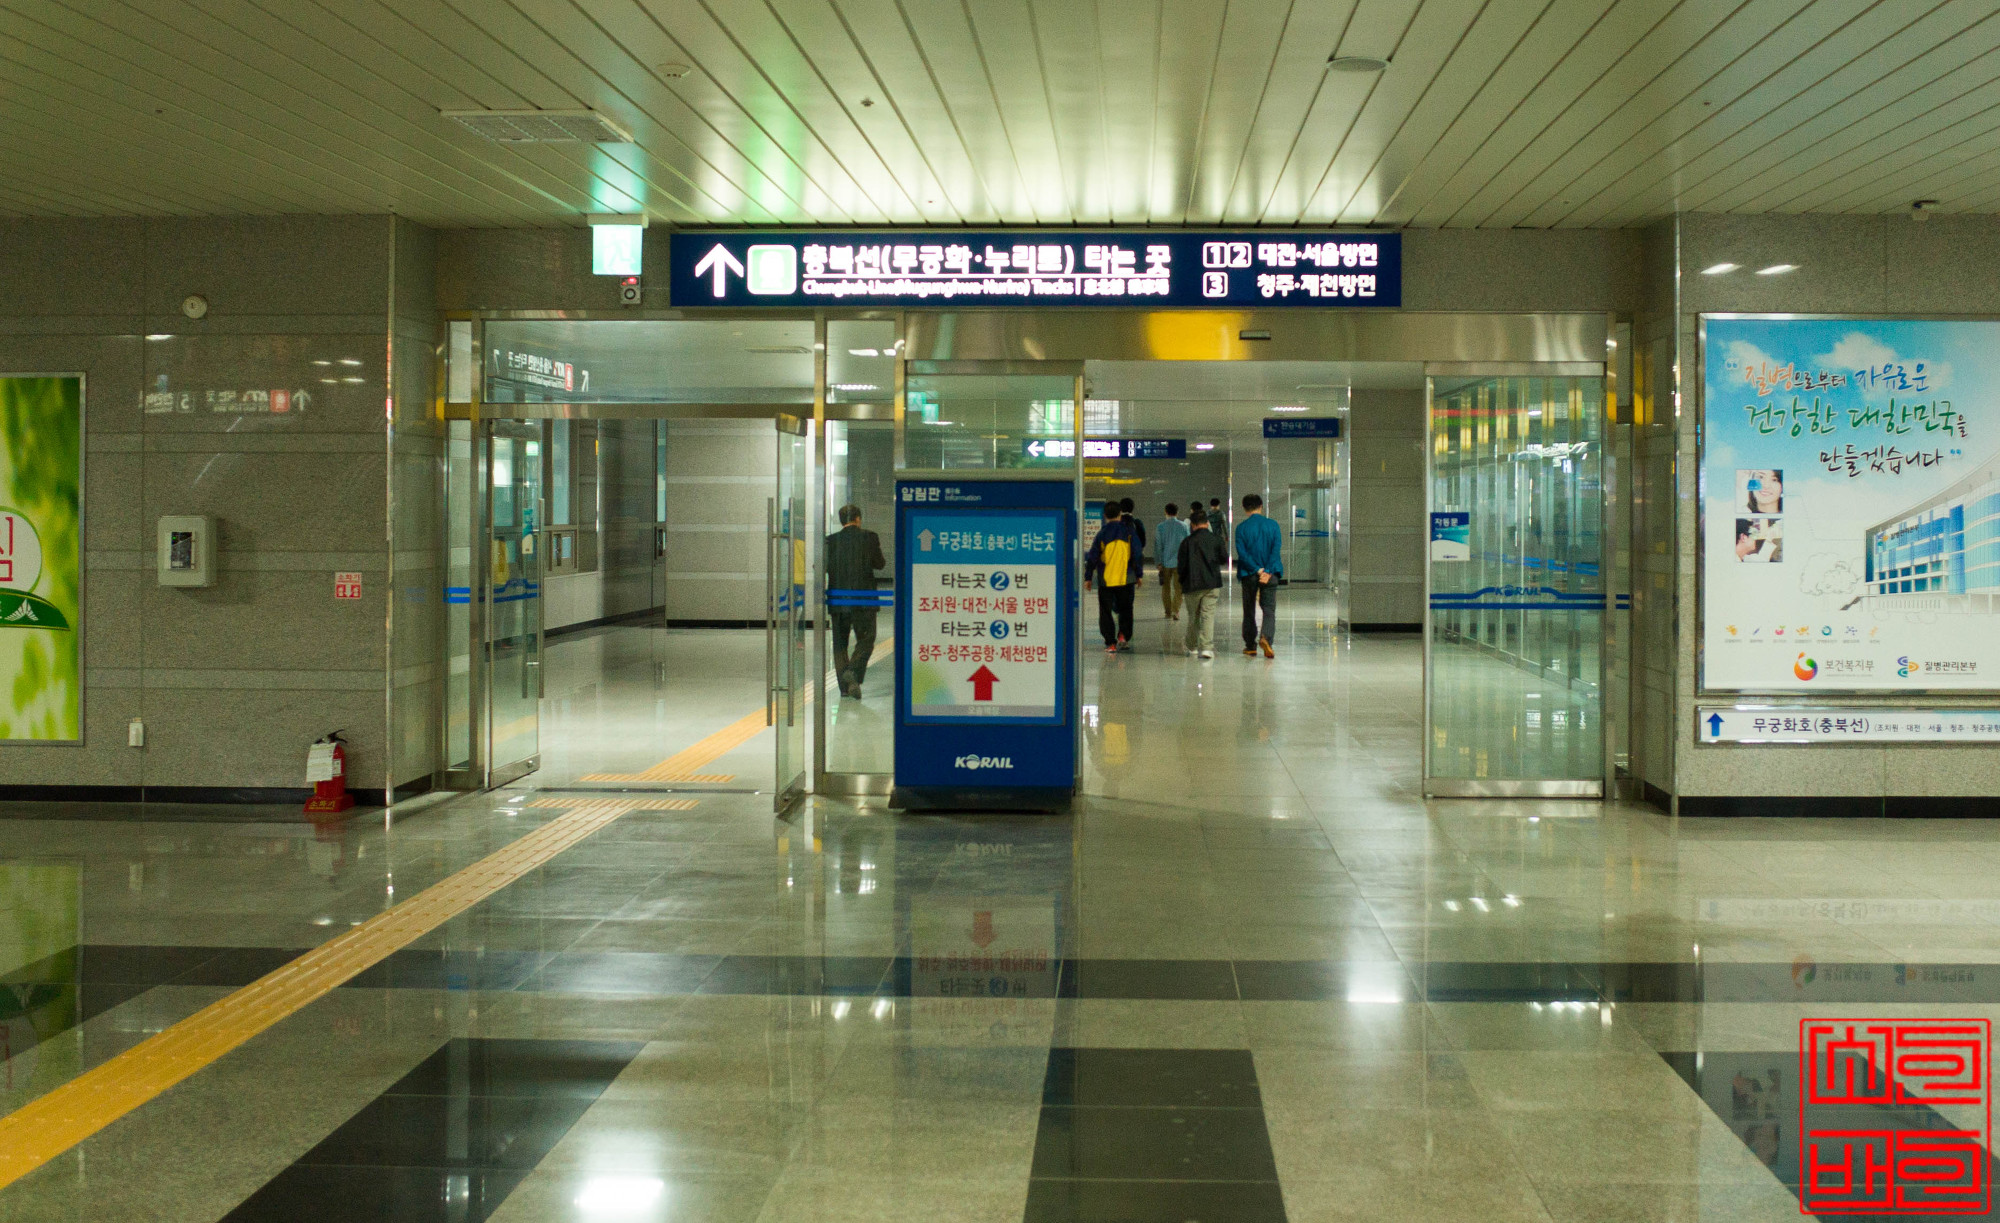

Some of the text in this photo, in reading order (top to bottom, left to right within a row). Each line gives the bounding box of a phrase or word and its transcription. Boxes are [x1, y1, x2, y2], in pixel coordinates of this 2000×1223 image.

[1084, 244, 1136, 275] 타는
[1146, 244, 1171, 276] 곳
[1207, 243, 1225, 266] 1
[1230, 243, 1249, 266] 2
[1207, 273, 1377, 297] 3 청주·제천방면
[1855, 362, 1930, 391] 자유로운
[1745, 397, 1968, 438] 건강한 대한민국을
[902, 487, 941, 501] 알림판
[1434, 517, 1458, 527] 자동문
[939, 531, 1055, 552] 무궁화호(충북선) 타는곳
[941, 573, 986, 589] 타는곳
[1014, 573, 1028, 589] 번
[1024, 596, 1049, 615] 방면
[941, 621, 986, 637] 타는곳
[1014, 621, 1028, 638] 번
[1825, 659, 1875, 673] 보건복지부
[1924, 660, 1978, 672] 질병관리본부
[1752, 717, 1870, 734] 무궁화호(충북선)
[1906, 722, 1921, 733] 대전
[1928, 722, 1943, 733] 서울
[955, 754, 1014, 770] KORAIL
